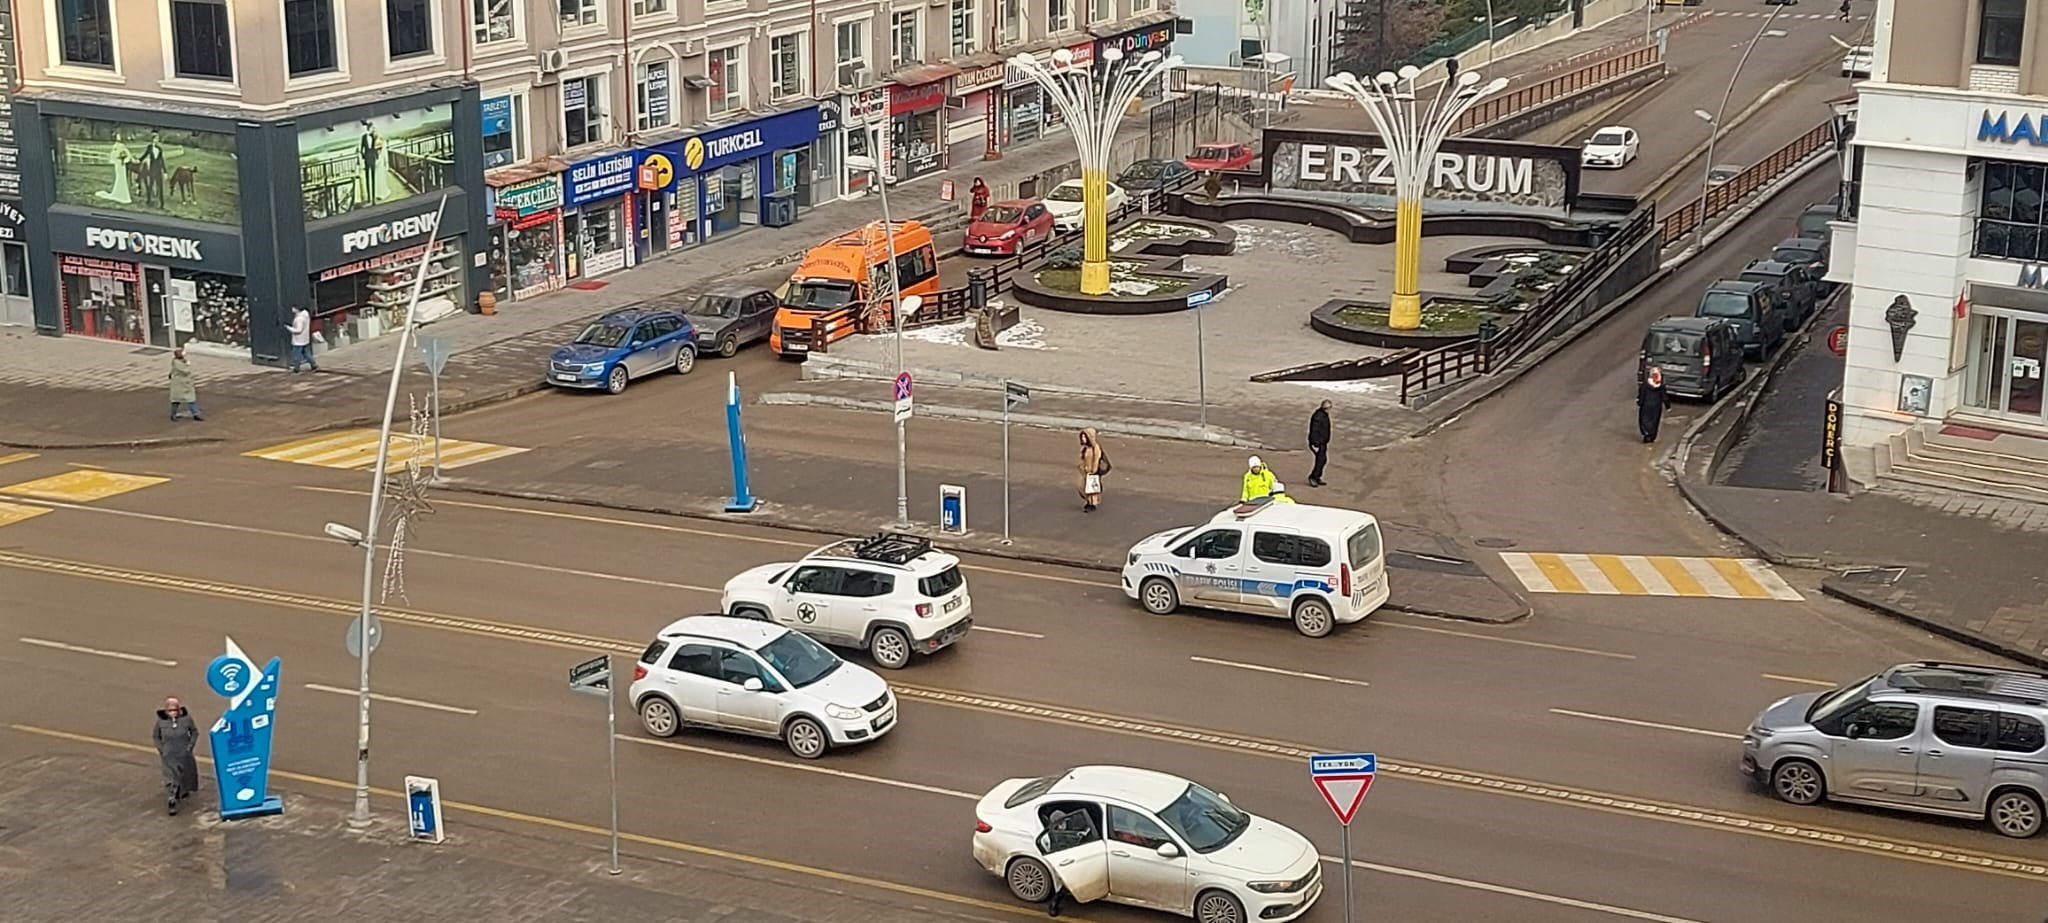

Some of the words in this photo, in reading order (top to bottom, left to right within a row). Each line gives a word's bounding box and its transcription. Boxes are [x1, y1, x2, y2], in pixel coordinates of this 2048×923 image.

[1126, 29, 1169, 50] Dünyası
[706, 129, 764, 158] TURKCELL
[1301, 144, 1533, 194] ERZRUM
[86, 227, 202, 260] FOTORENK
[343, 211, 438, 253] FOTORENK
